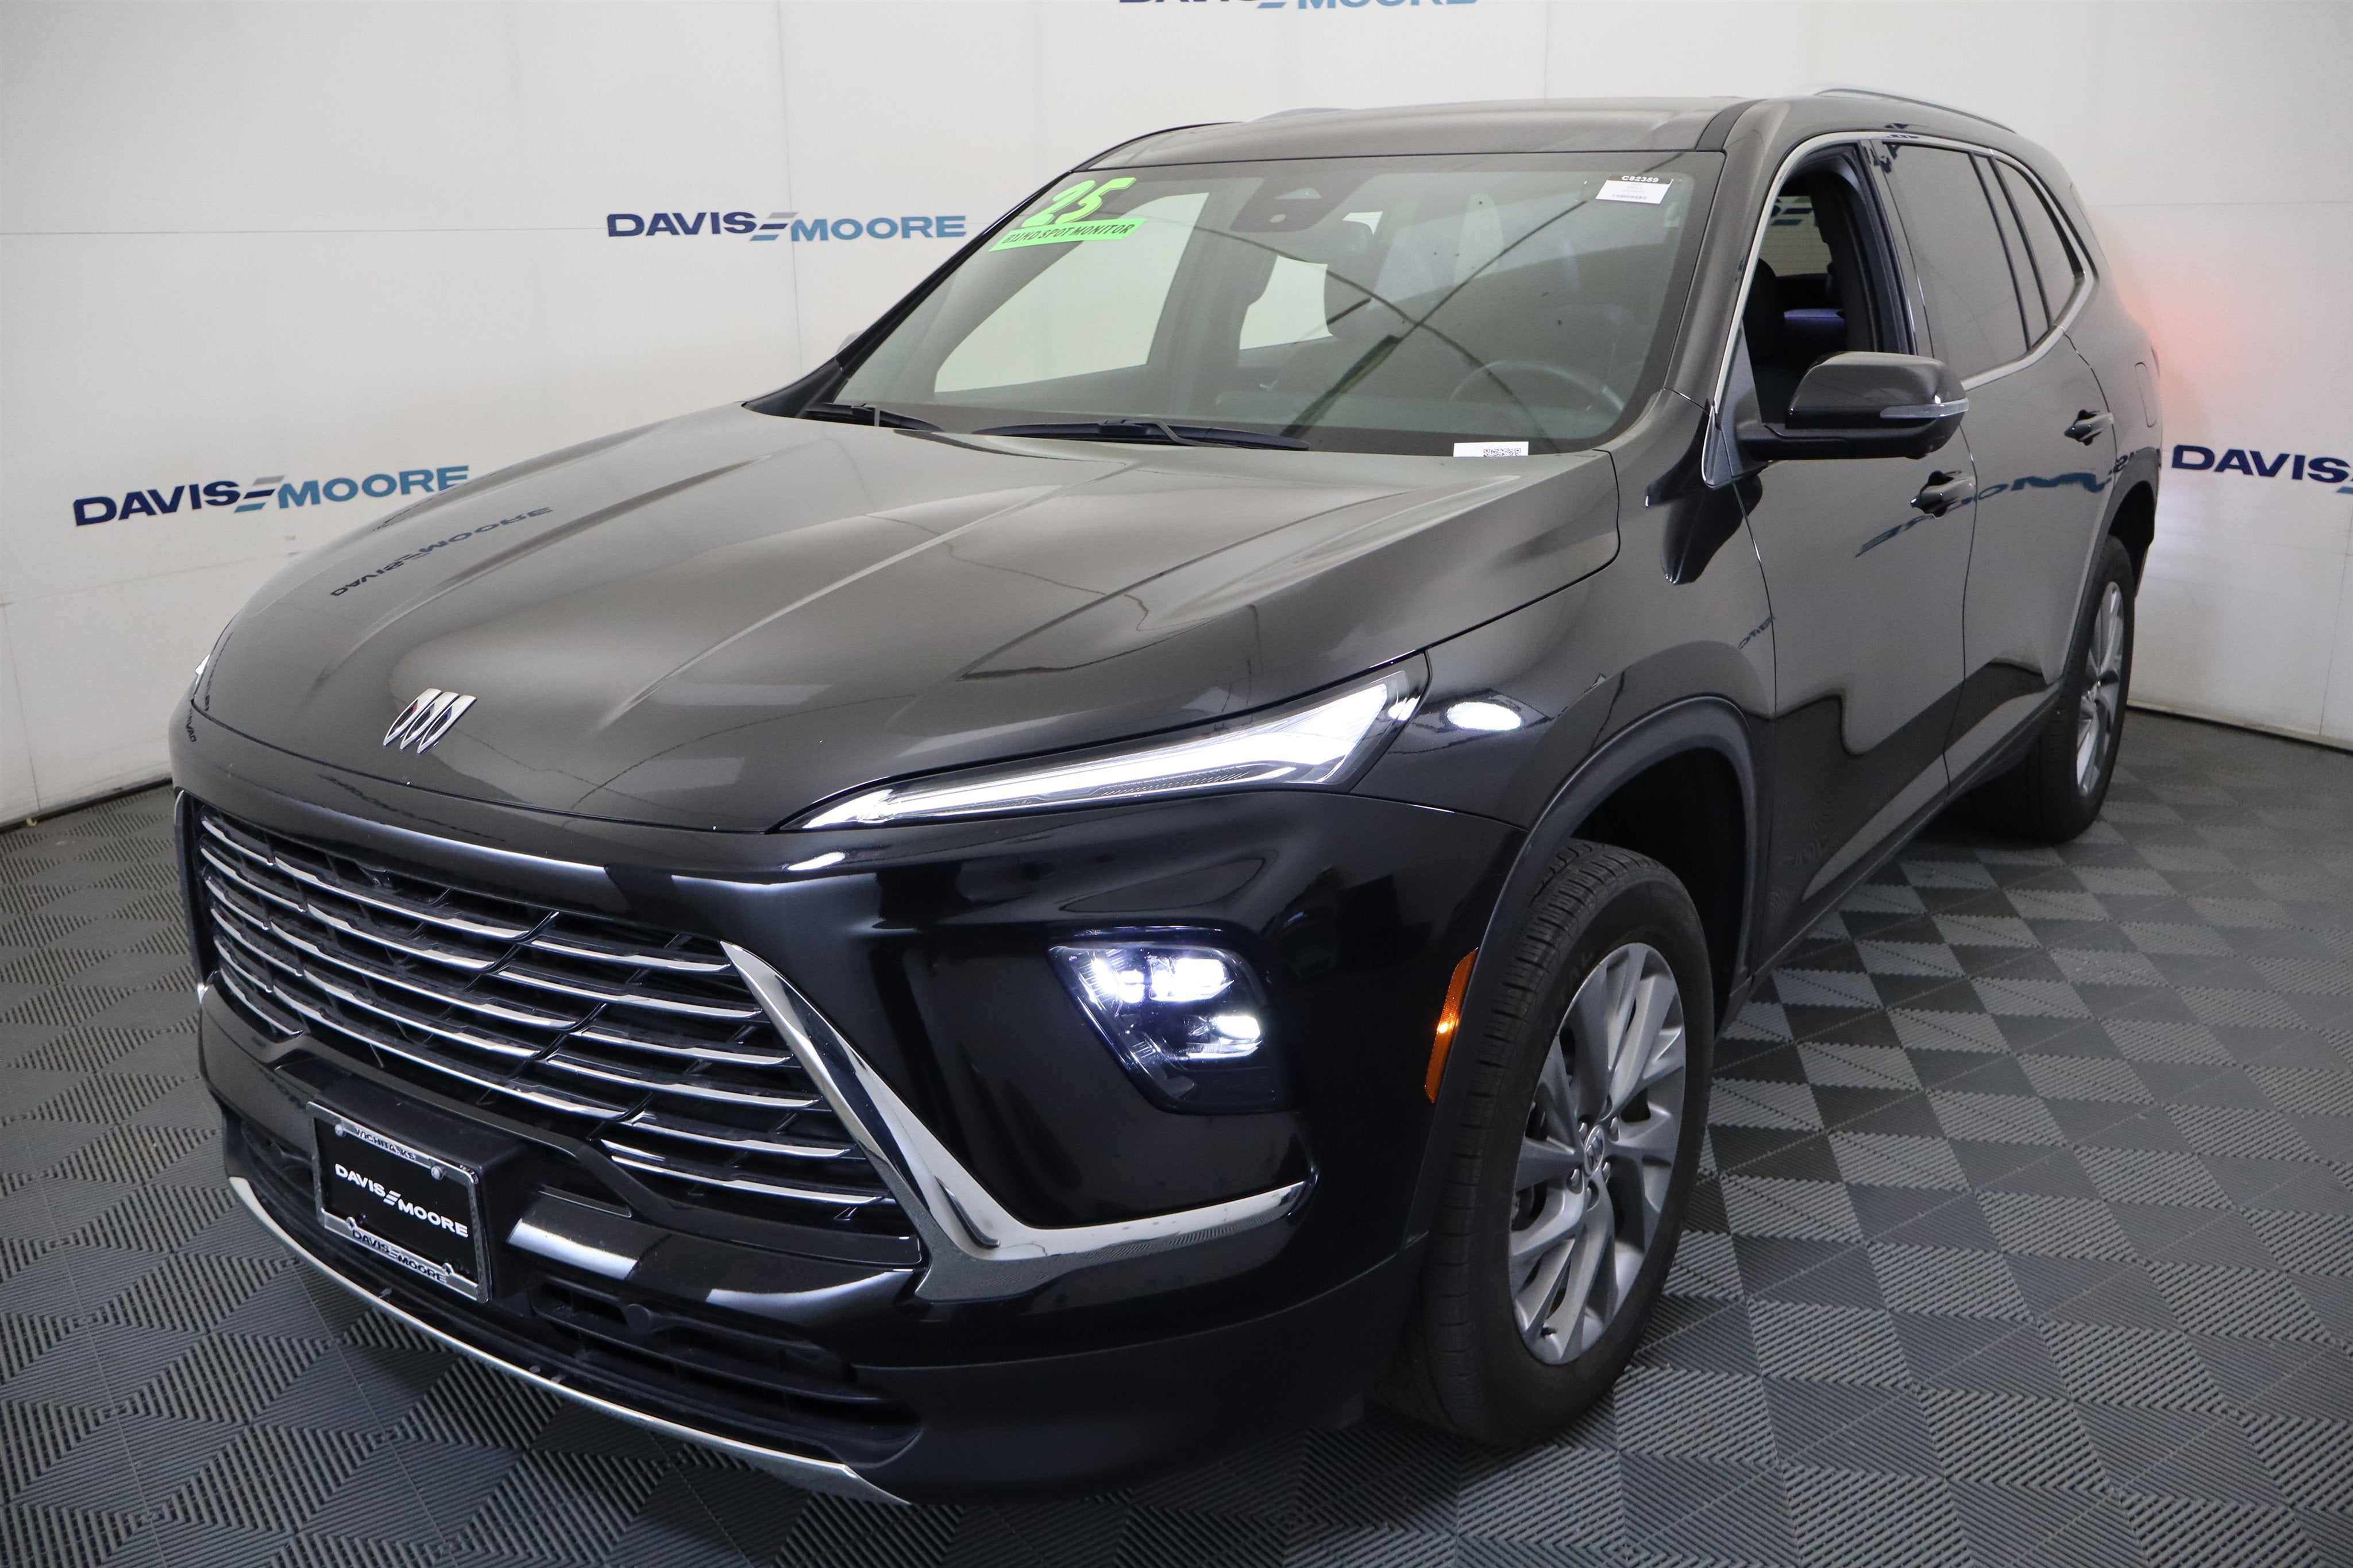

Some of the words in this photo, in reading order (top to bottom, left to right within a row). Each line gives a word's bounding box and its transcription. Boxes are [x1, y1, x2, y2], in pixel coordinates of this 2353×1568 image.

[1621, 175, 1660, 183] C82359
[1021, 177, 1137, 227] 25
[607, 212, 757, 237] DAVIS
[790, 215, 967, 241] MOORE
[1001, 230, 1042, 244] BLIND
[1038, 227, 1075, 240] SPOT
[1069, 223, 1136, 237] MONITOR
[2171, 444, 2350, 483] DAVIS
[73, 481, 241, 526] DAVIS
[277, 465, 469, 510] MOORE
[335, 1163, 386, 1198] DAVIS
[398, 1198, 469, 1238] MOORE
[352, 1229, 390, 1255] DAVIS
[396, 1252, 448, 1284] MOORE
